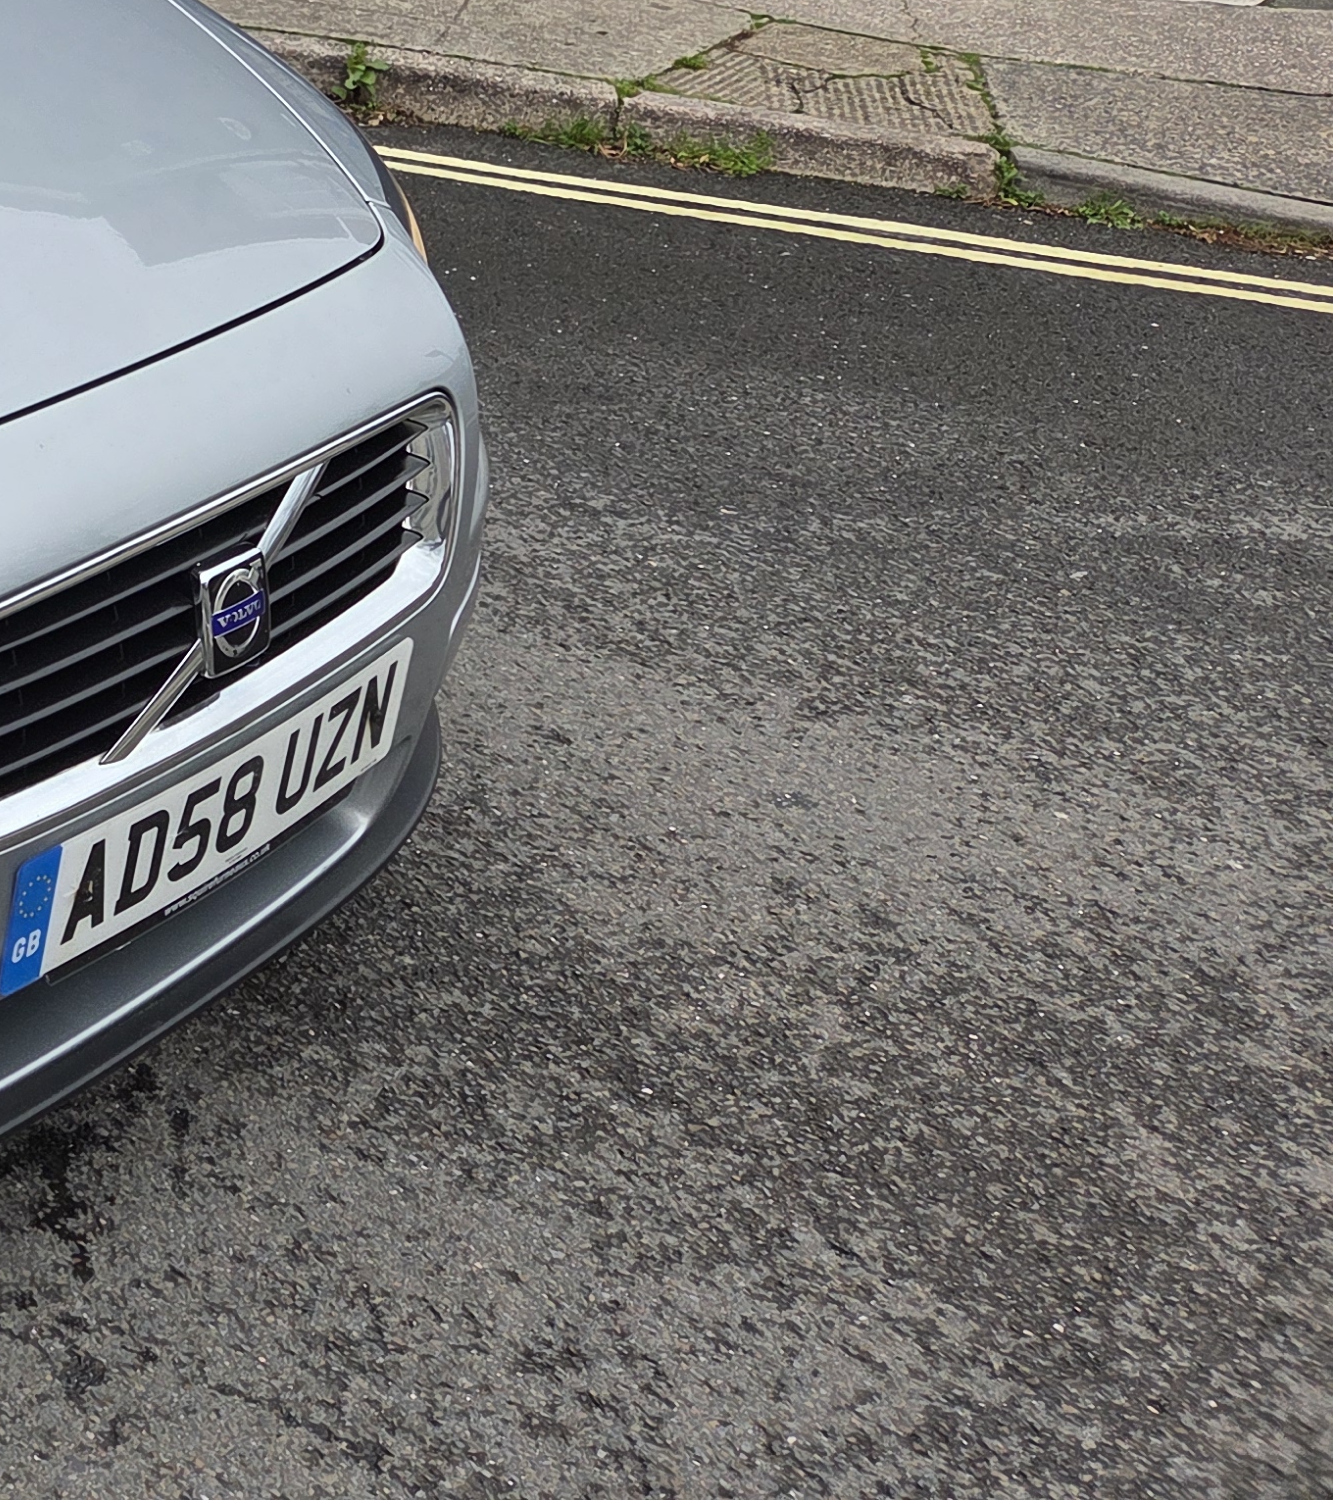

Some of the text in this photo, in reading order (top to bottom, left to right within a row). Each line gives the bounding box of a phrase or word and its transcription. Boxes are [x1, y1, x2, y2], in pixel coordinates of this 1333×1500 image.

[216, 599, 261, 628] VOLVO
[60, 659, 399, 945] AD58 UZN
[11, 928, 42, 964] GB
